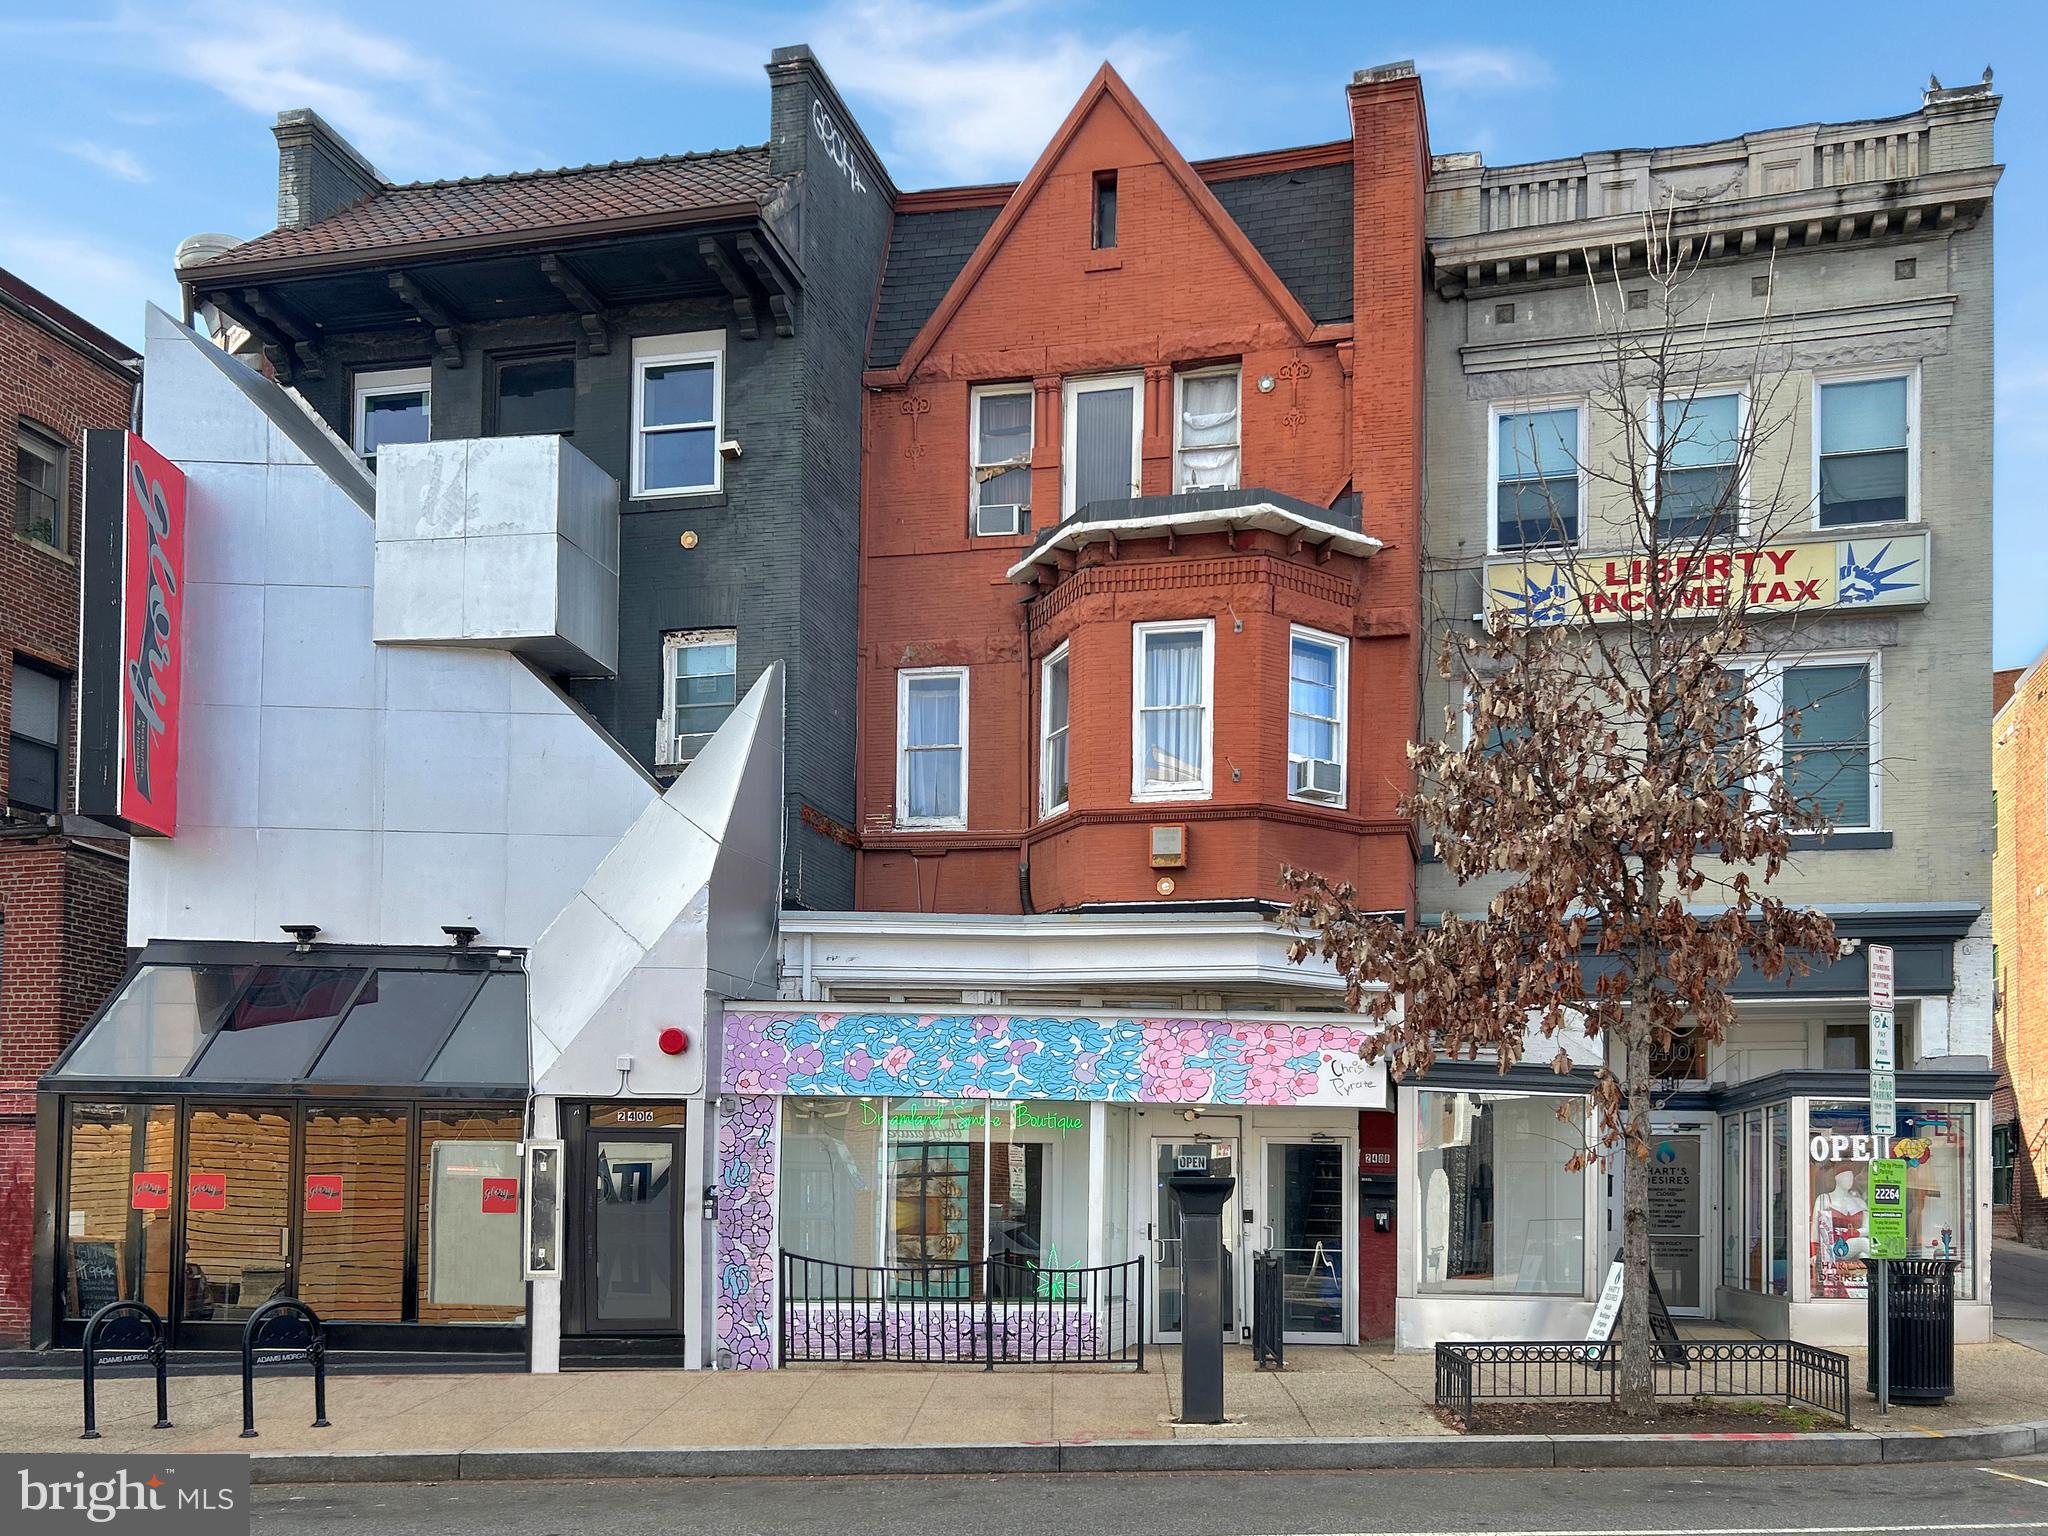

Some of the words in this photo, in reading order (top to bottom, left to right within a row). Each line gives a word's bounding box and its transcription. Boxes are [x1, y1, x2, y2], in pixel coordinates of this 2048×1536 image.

[1605, 549, 1797, 586] LIBERTY
[1583, 585, 1730, 614] INCOME
[1743, 579, 1821, 605] TAX
[1878, 1031, 1886, 1039] PAY
[1331, 1060, 1365, 1077] Chris
[1878, 1080, 1892, 1090] HOUR
[1873, 1091, 1893, 1101] PARKING
[617, 1111, 654, 1122] 2406
[1014, 1103, 1083, 1139] Boutique
[1179, 1156, 1206, 1169] OPEN
[1648, 1176, 1690, 1184] ESIRES
[1875, 1188, 1900, 1200] 22264
[98, 1355, 123, 1365] ADAMS
[123, 1354, 150, 1363] MORGA
[256, 1354, 281, 1364] ADAMS
[282, 1352, 307, 1362] MORGA
